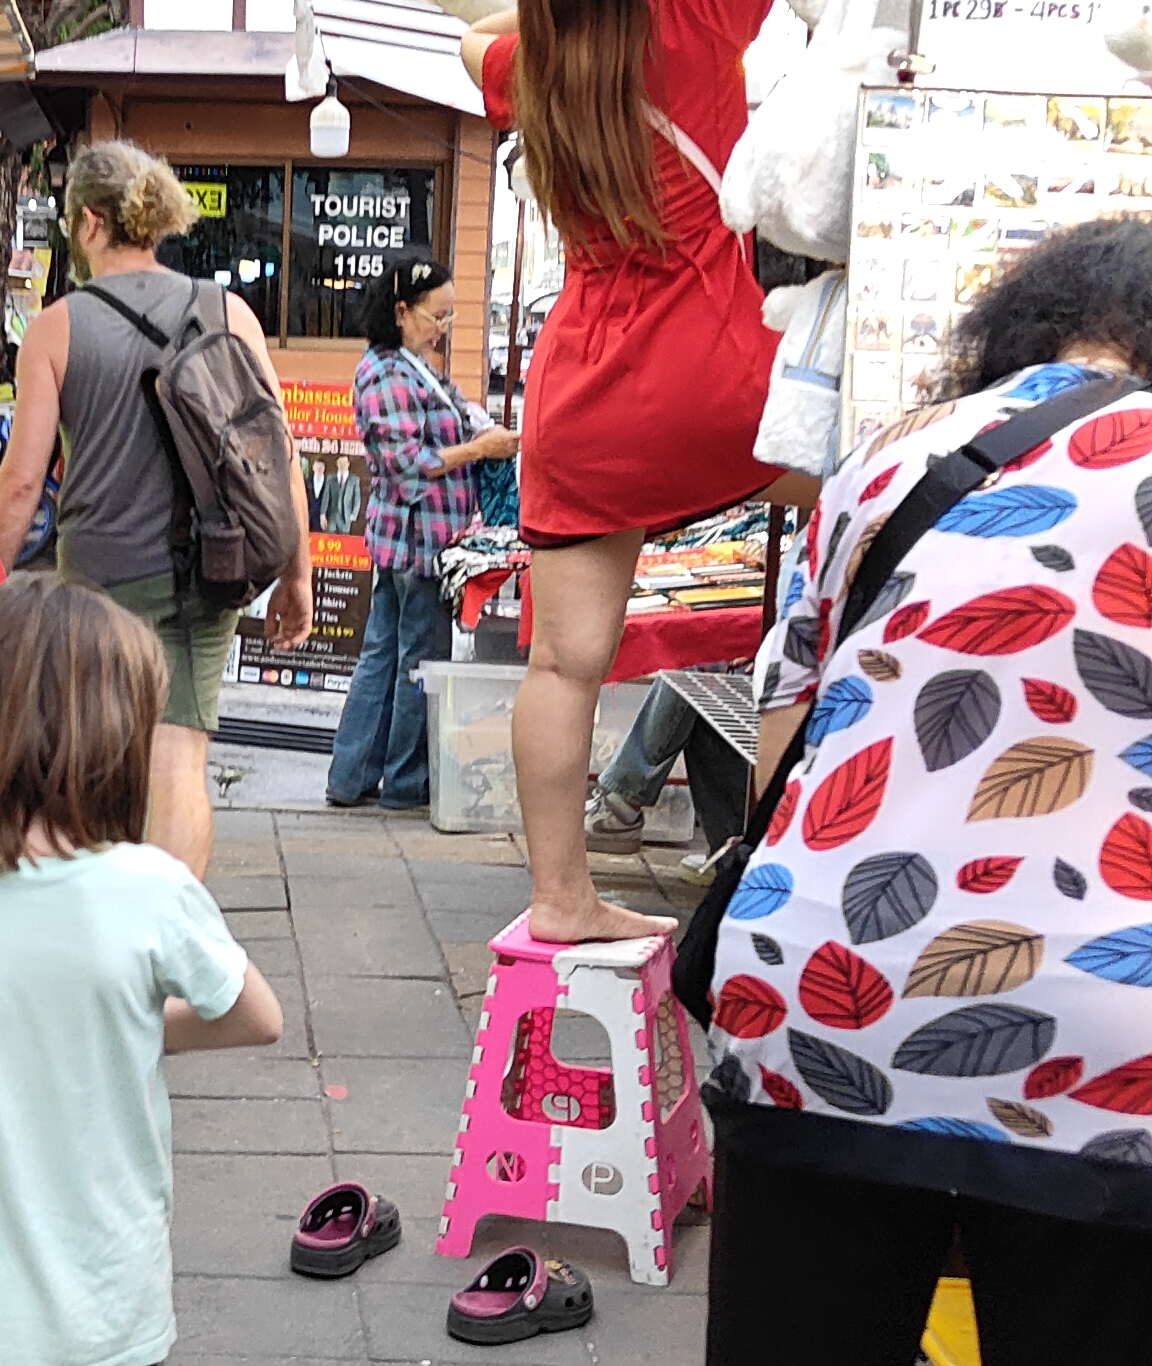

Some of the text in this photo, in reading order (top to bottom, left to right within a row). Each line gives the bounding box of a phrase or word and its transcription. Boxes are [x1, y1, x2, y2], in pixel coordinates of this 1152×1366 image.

[310, 193, 411, 219] TOURIST
[318, 223, 405, 249] POLICE
[334, 254, 384, 278] 1155
